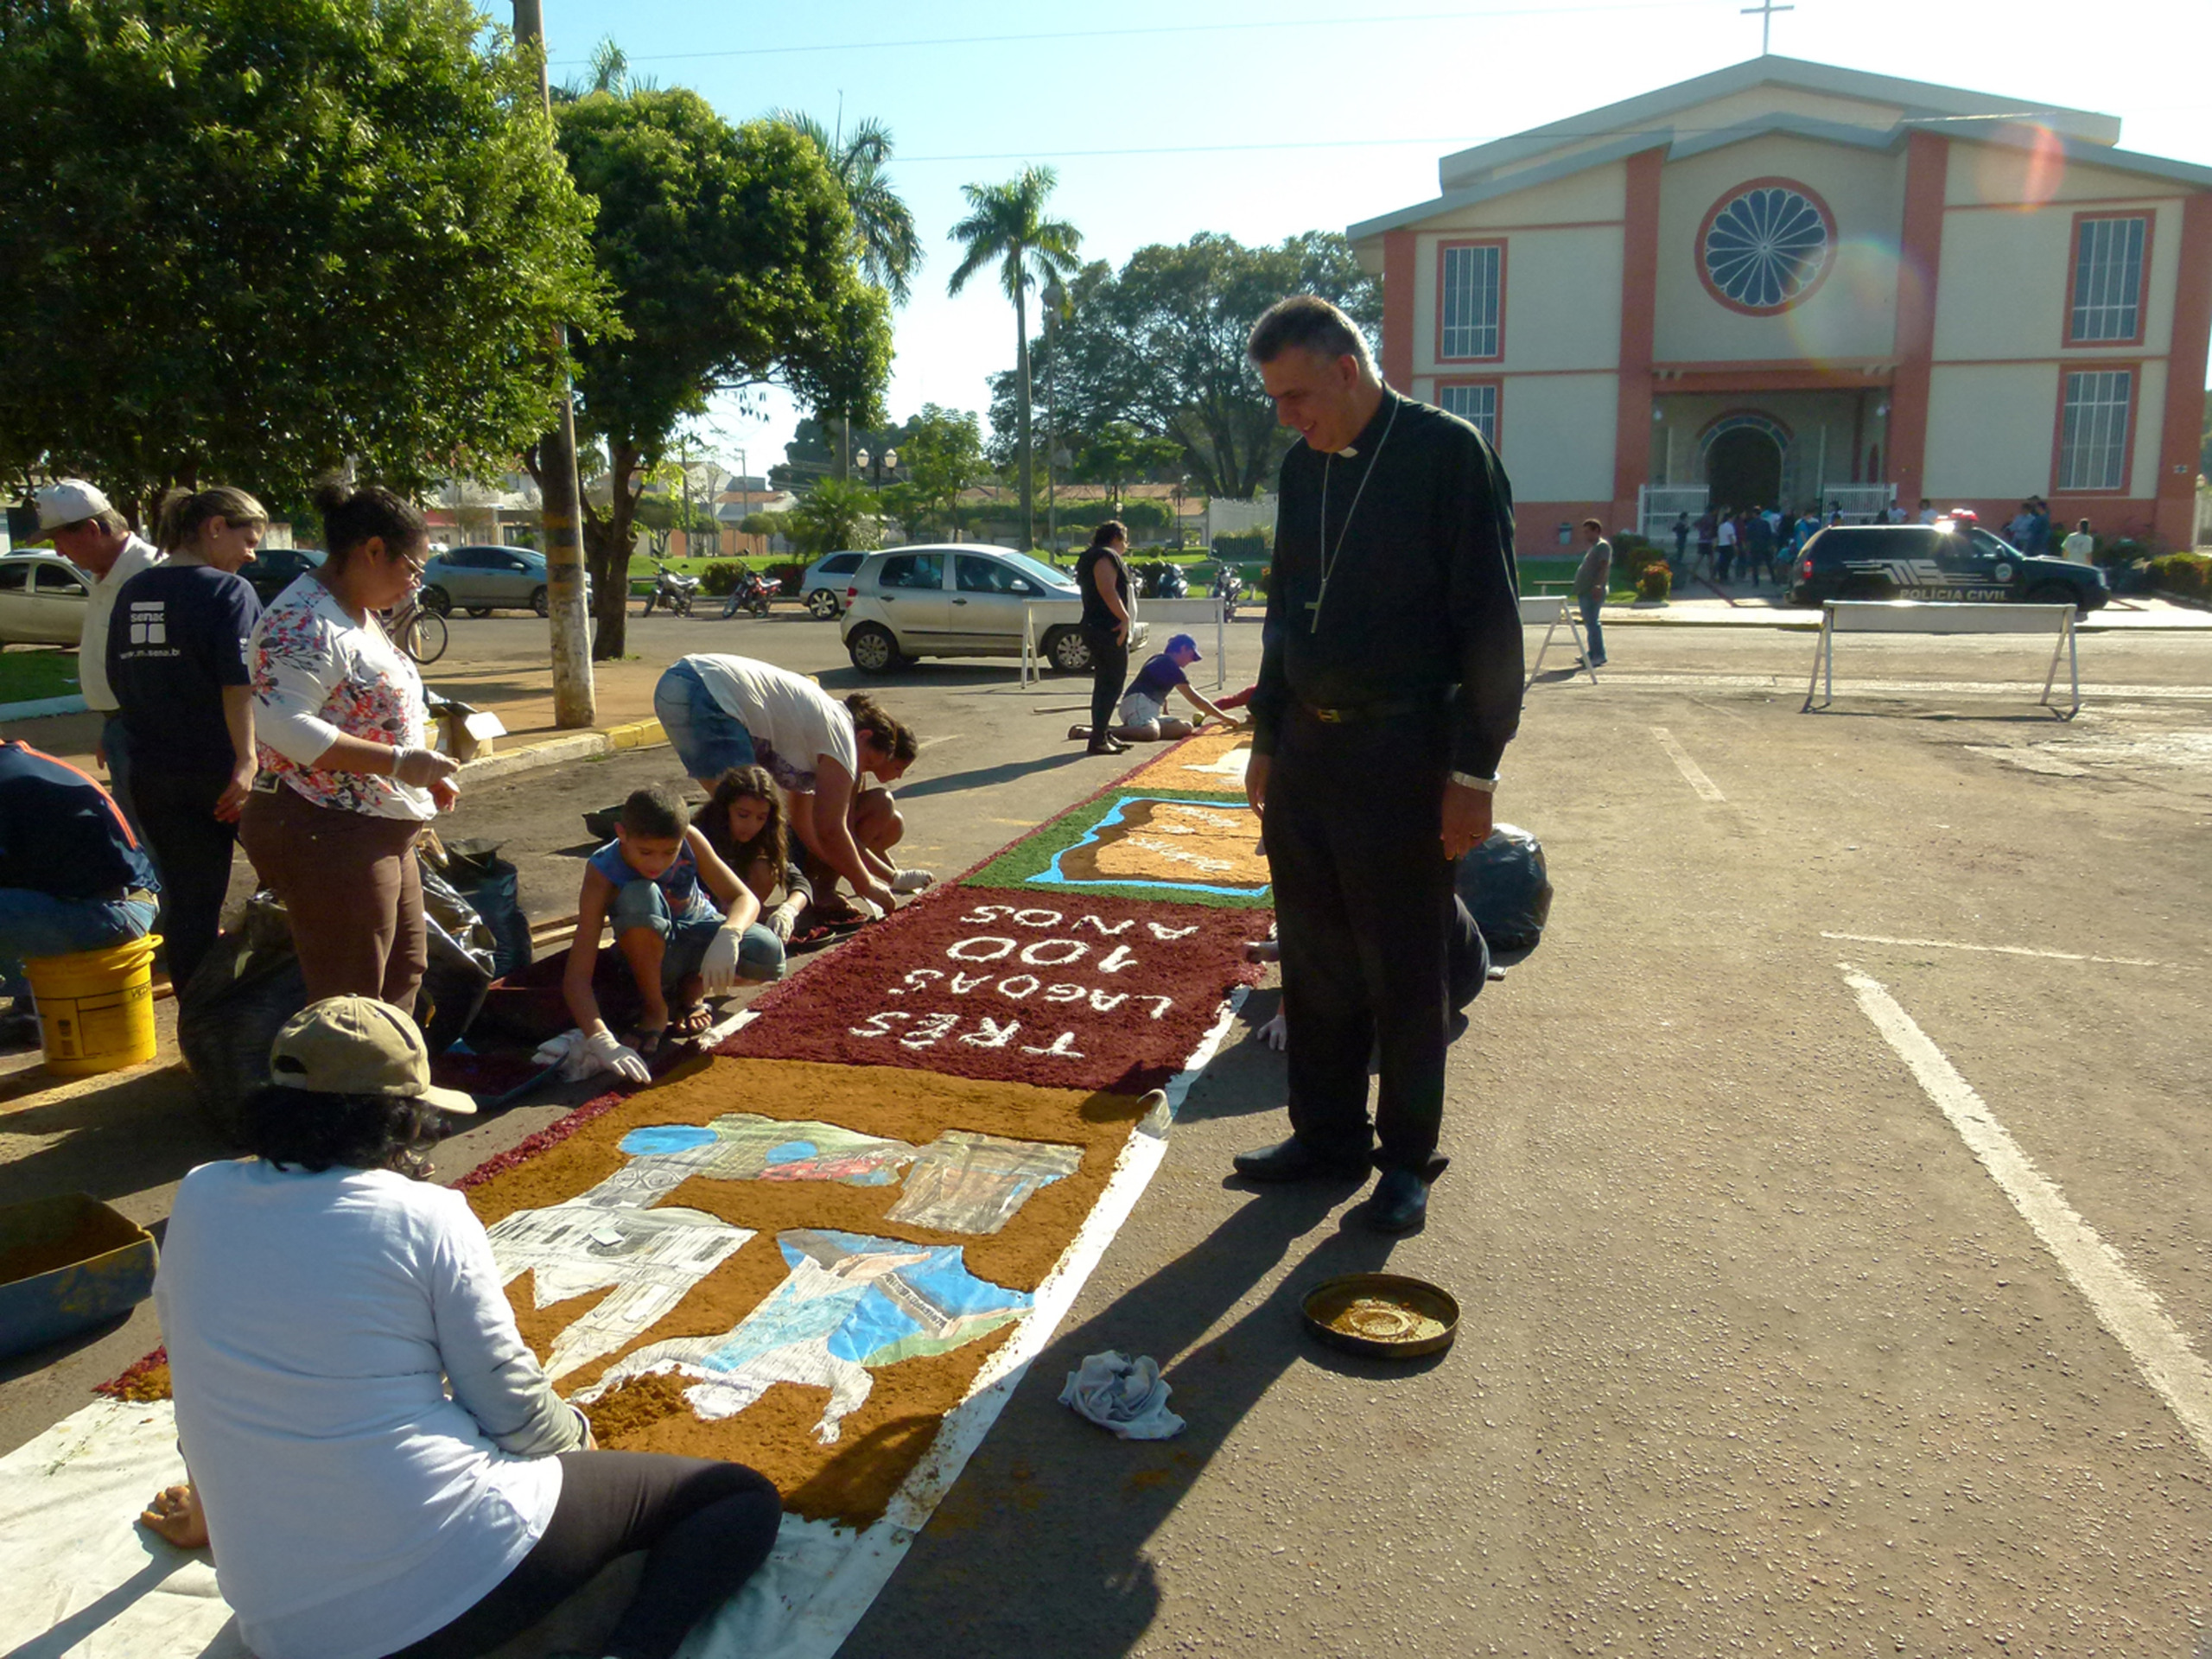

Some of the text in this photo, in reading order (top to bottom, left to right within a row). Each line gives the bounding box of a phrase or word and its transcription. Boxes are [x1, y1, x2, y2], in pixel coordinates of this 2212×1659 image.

[1900, 588, 2006, 601] POLÍCIA CIVIL
[130, 613, 165, 623] senac
[960, 906, 1200, 940] ANOS
[946, 937, 1138, 974] 100
[888, 969, 1174, 1020] LAGOAS
